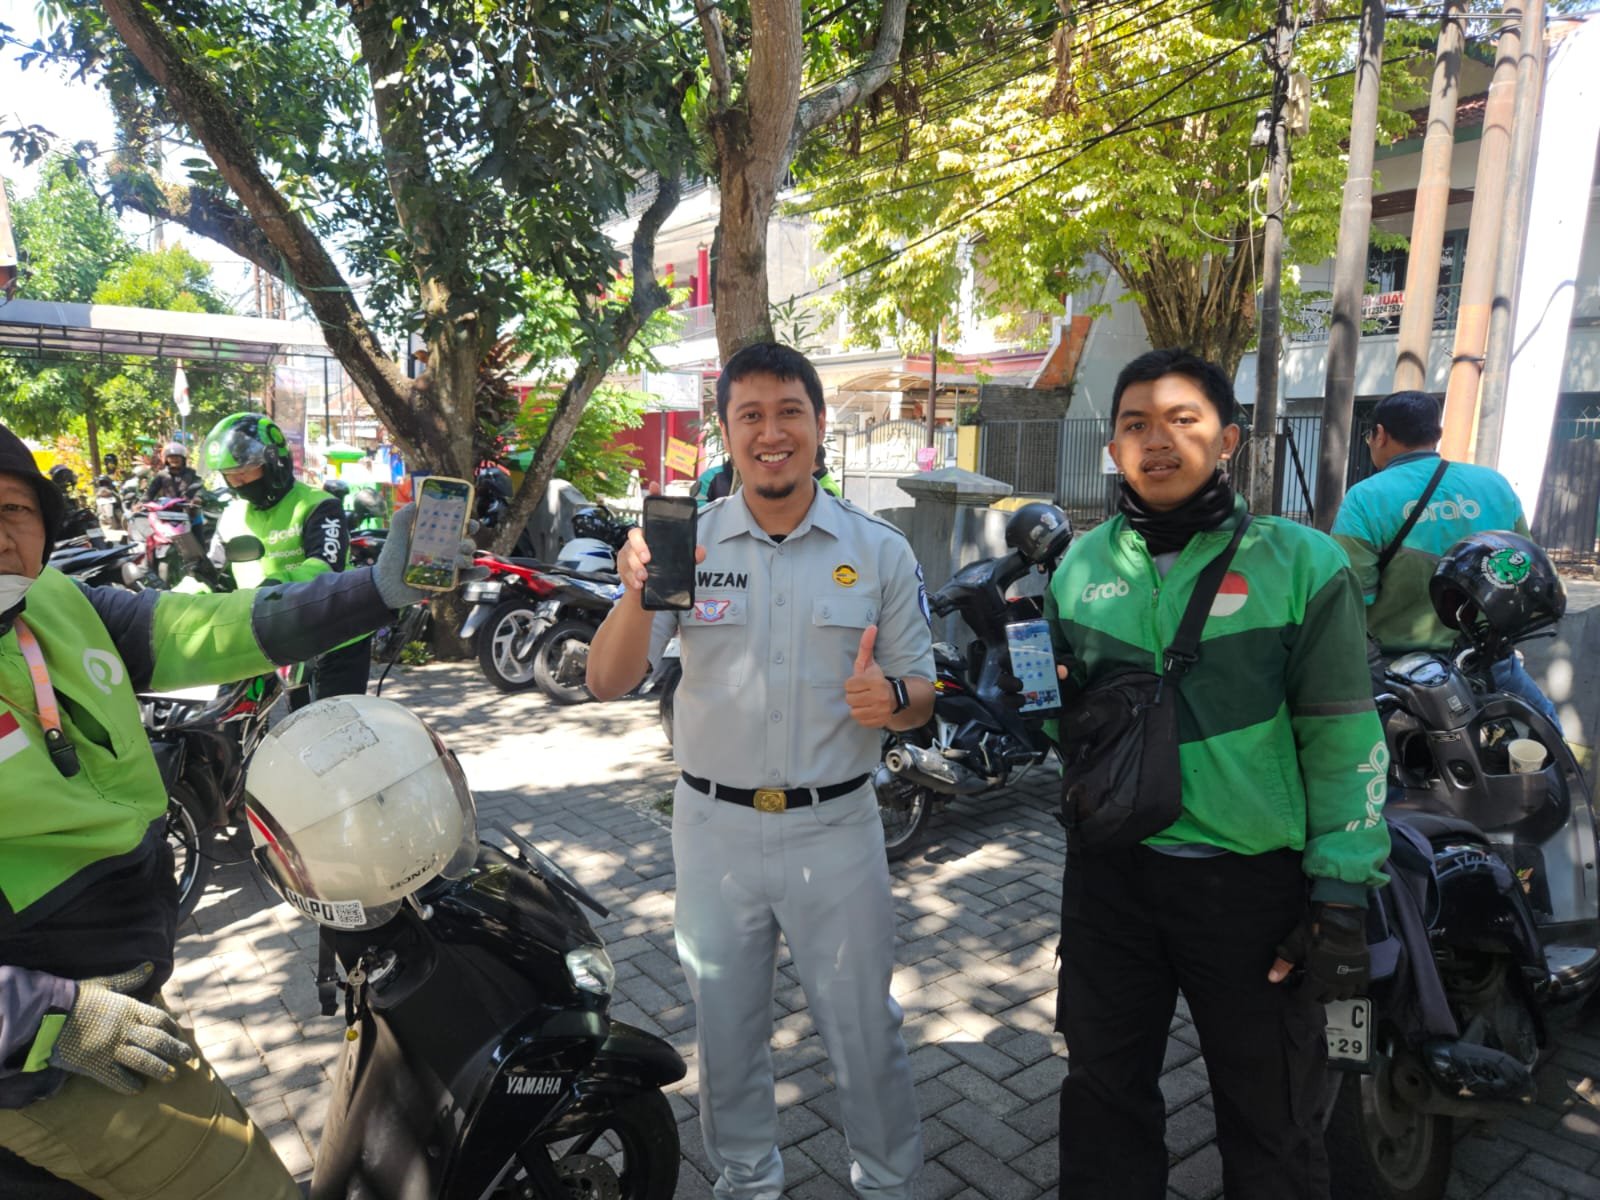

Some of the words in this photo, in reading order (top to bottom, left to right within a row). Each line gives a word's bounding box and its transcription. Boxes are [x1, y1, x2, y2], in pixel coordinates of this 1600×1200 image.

[321, 517, 341, 564] gojek
[697, 571, 748, 589] WZAN
[1081, 575, 1130, 603] Grab
[1351, 1004, 1364, 1029] C
[506, 1076, 562, 1095] YAMAHA
